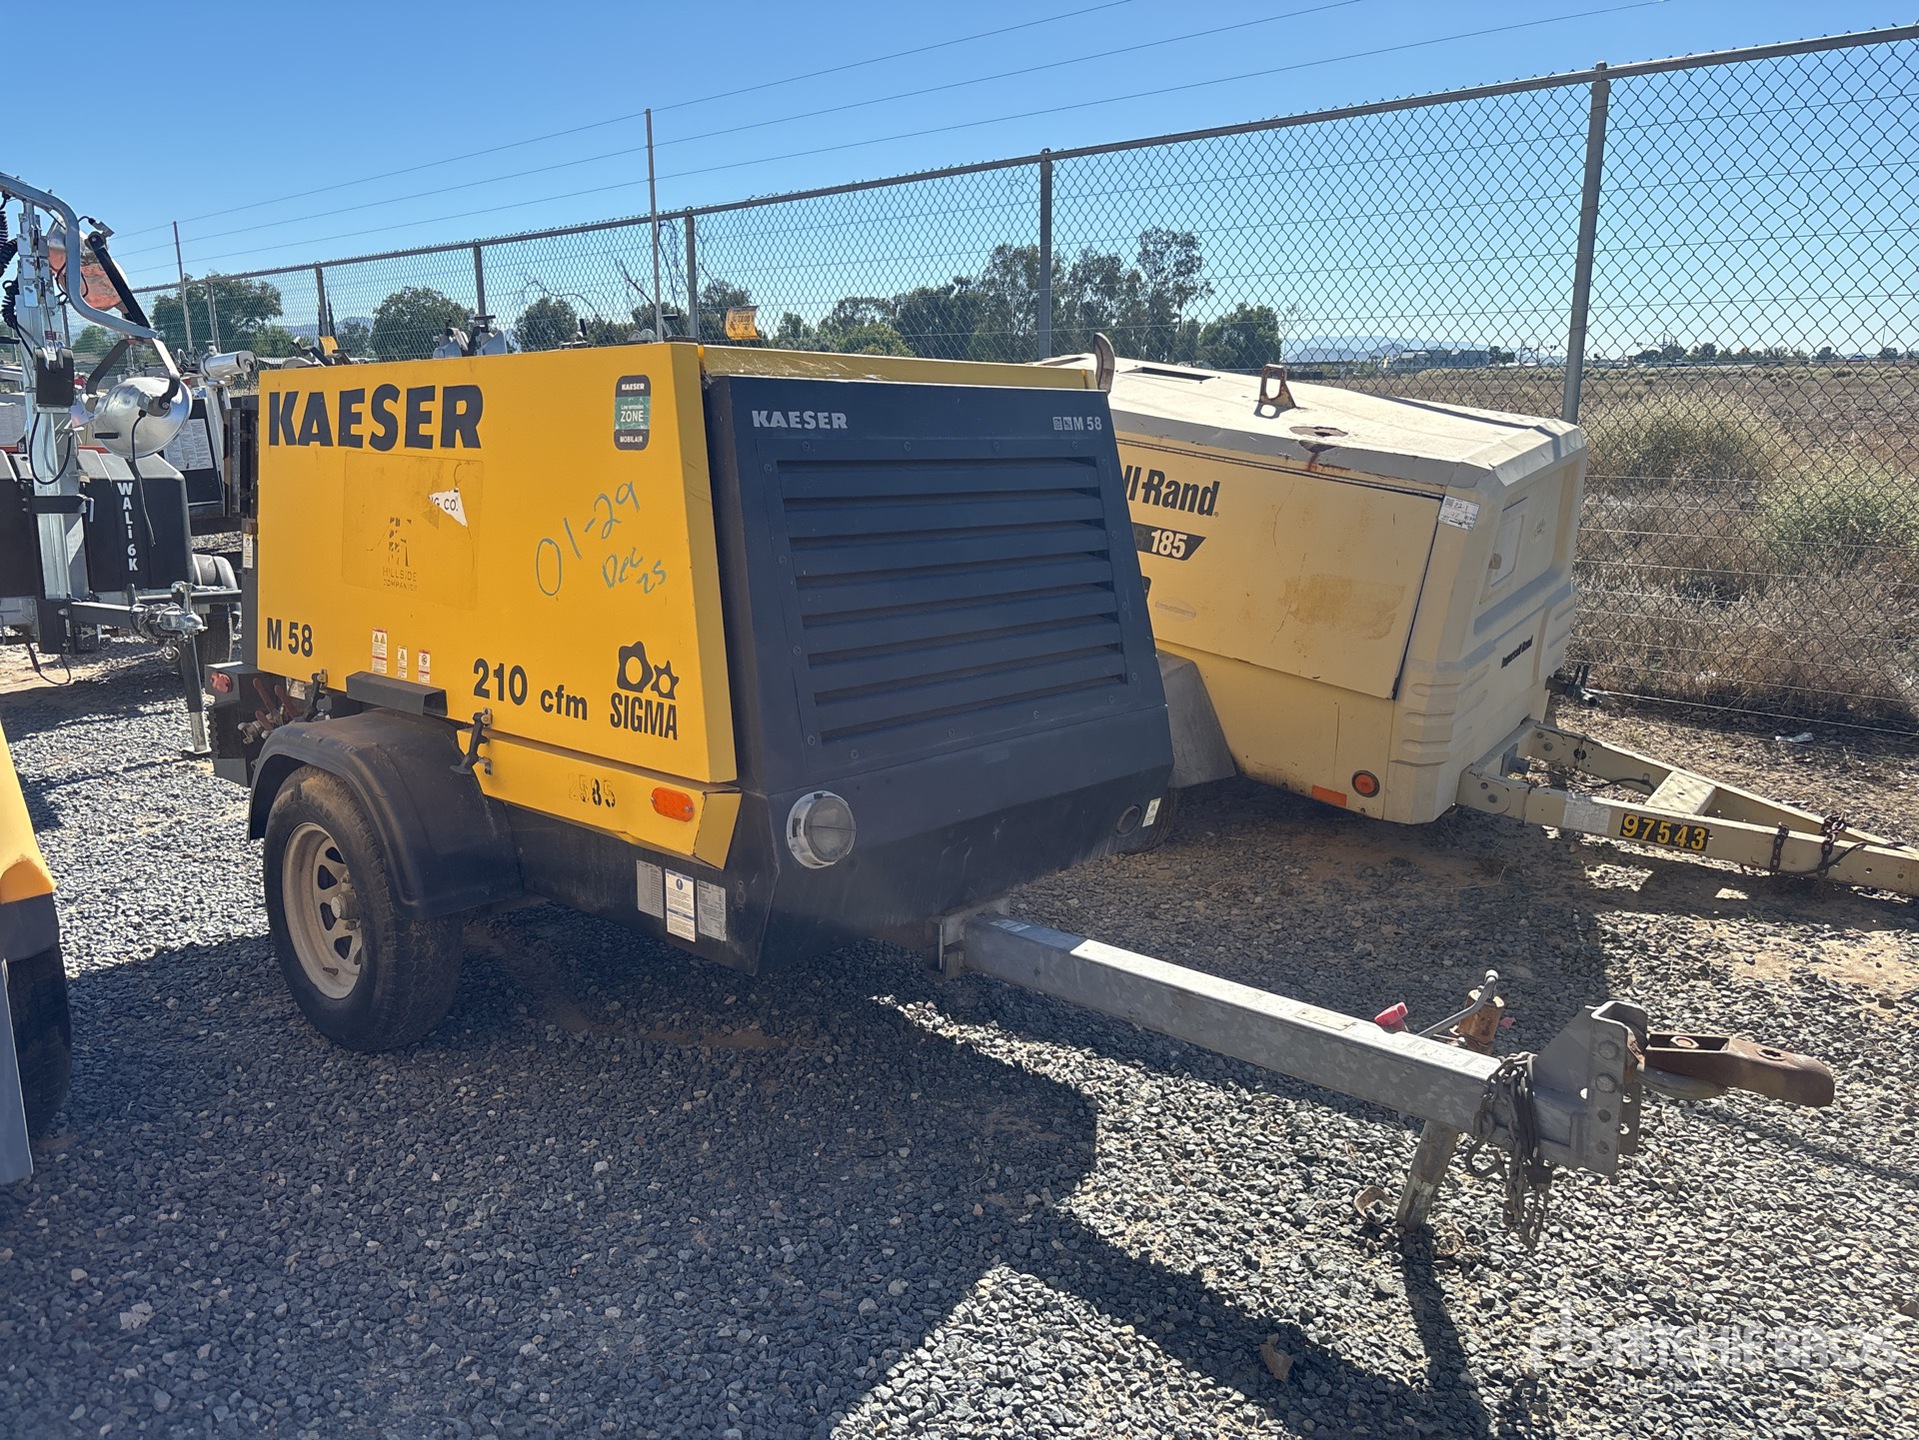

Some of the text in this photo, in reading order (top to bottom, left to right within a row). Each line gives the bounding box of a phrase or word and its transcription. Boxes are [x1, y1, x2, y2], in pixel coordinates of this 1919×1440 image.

[621, 383, 645, 391] KAESER
[268, 383, 484, 452] KAESER
[620, 410, 644, 422] ZONE
[751, 410, 848, 430] KAESER
[1072, 416, 1084, 431] M
[1086, 416, 1102, 431] 58
[443, 498, 459, 512] CO.
[1124, 464, 1220, 517] ll-Rand
[535, 481, 641, 597] 01-29
[1150, 529, 1188, 559] 185
[637, 560, 667, 594] 25
[266, 617, 313, 658] M 58
[473, 658, 528, 706] 210
[540, 684, 588, 721] cfm
[610, 692, 679, 741] SIGMA
[1622, 814, 1706, 850] 97543
